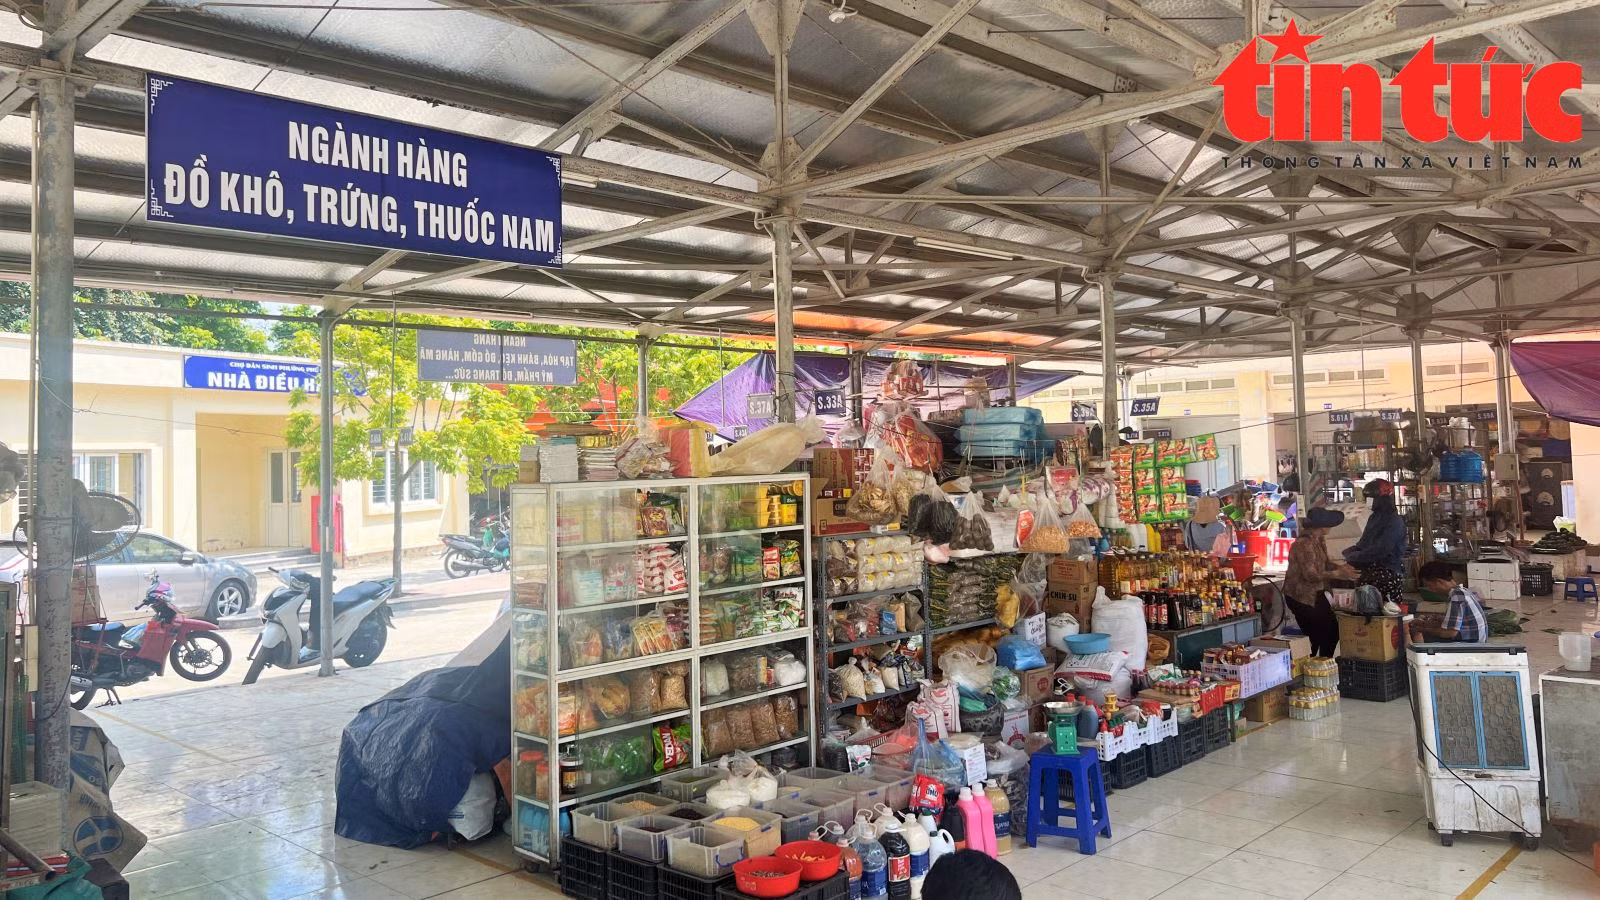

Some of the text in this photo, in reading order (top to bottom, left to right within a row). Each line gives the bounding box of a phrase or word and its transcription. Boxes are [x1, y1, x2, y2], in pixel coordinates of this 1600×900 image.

[289, 121, 468, 188] NGÀNH HÀNG
[164, 154, 554, 253] ĐỒ KHÔ, TRỨNG, THUỐC NAM
[208, 371, 251, 390] NHÀ
[255, 372, 300, 391] ĐIỀU
[750, 400, 772, 414] S.37A
[817, 395, 843, 411] S.33A
[1133, 403, 1156, 413] S.35A
[1050, 591, 1077, 601] CHIN-SU
